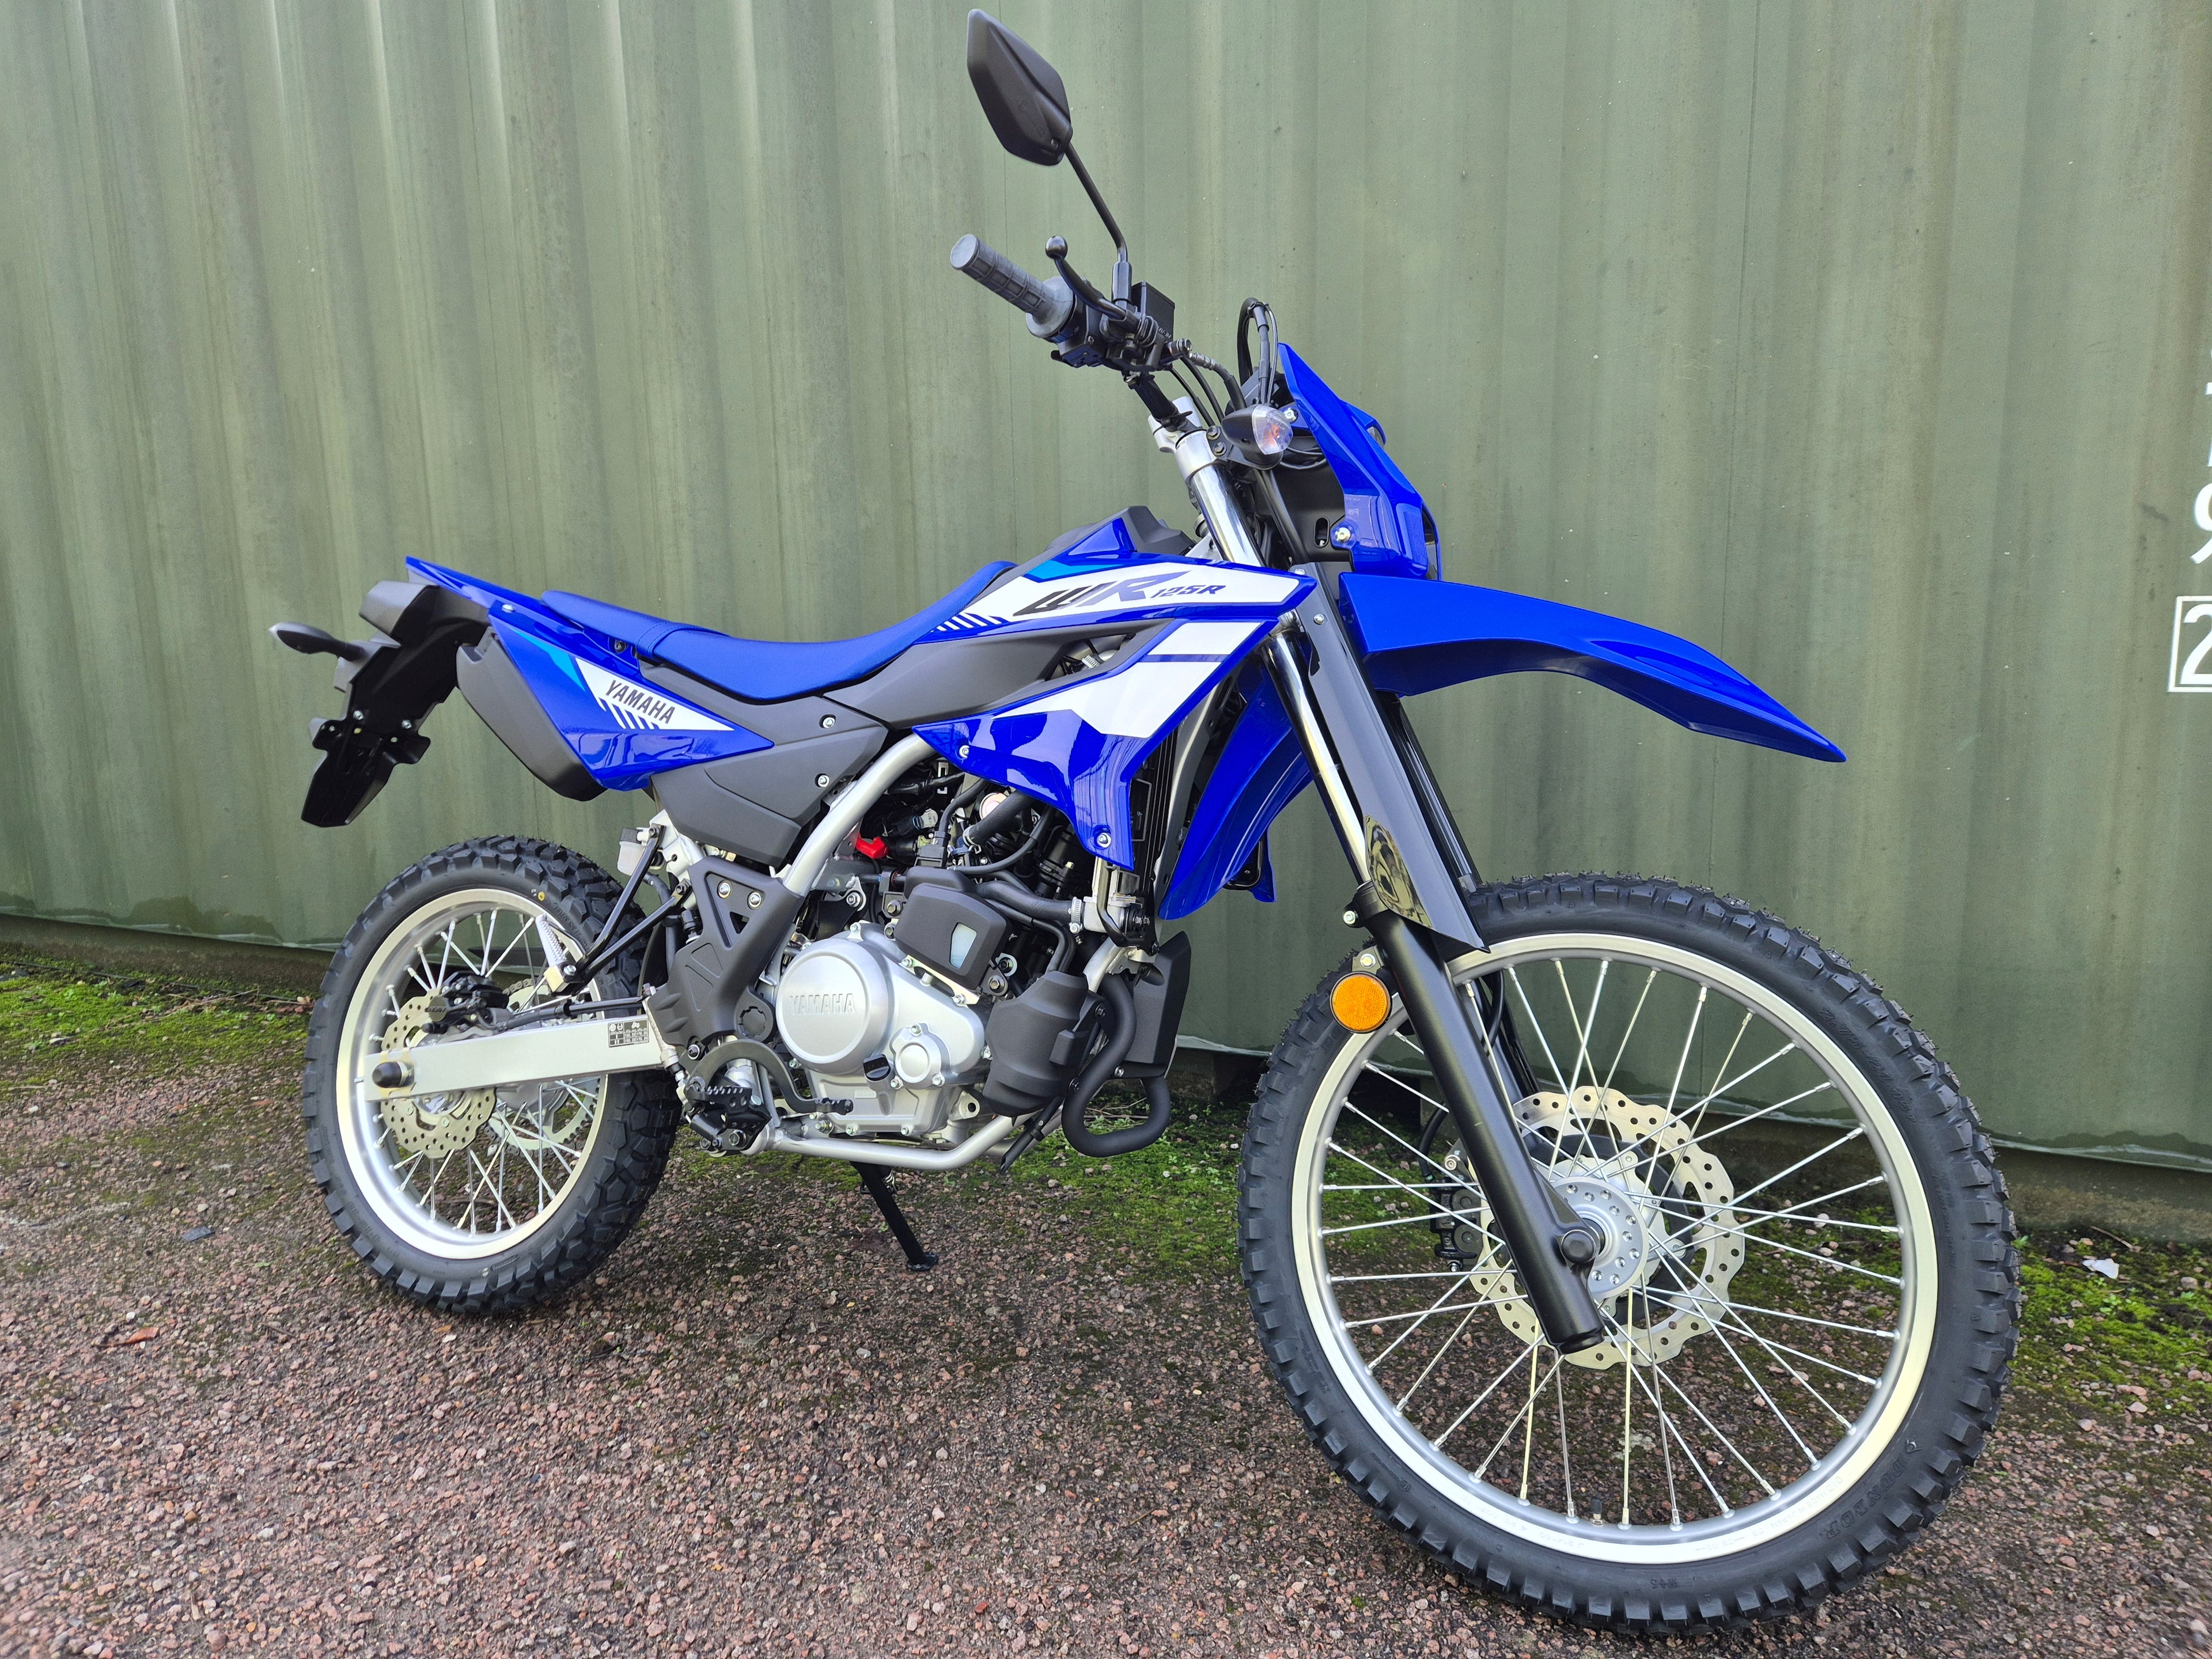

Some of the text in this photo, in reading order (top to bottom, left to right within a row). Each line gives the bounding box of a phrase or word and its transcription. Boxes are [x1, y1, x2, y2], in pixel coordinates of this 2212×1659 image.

[1013, 570, 1226, 616] WR 125R
[605, 680, 676, 724] YAMAHA
[789, 993, 855, 1016] YAMAHA
[1823, 1456, 1908, 1540] DUNLOP
